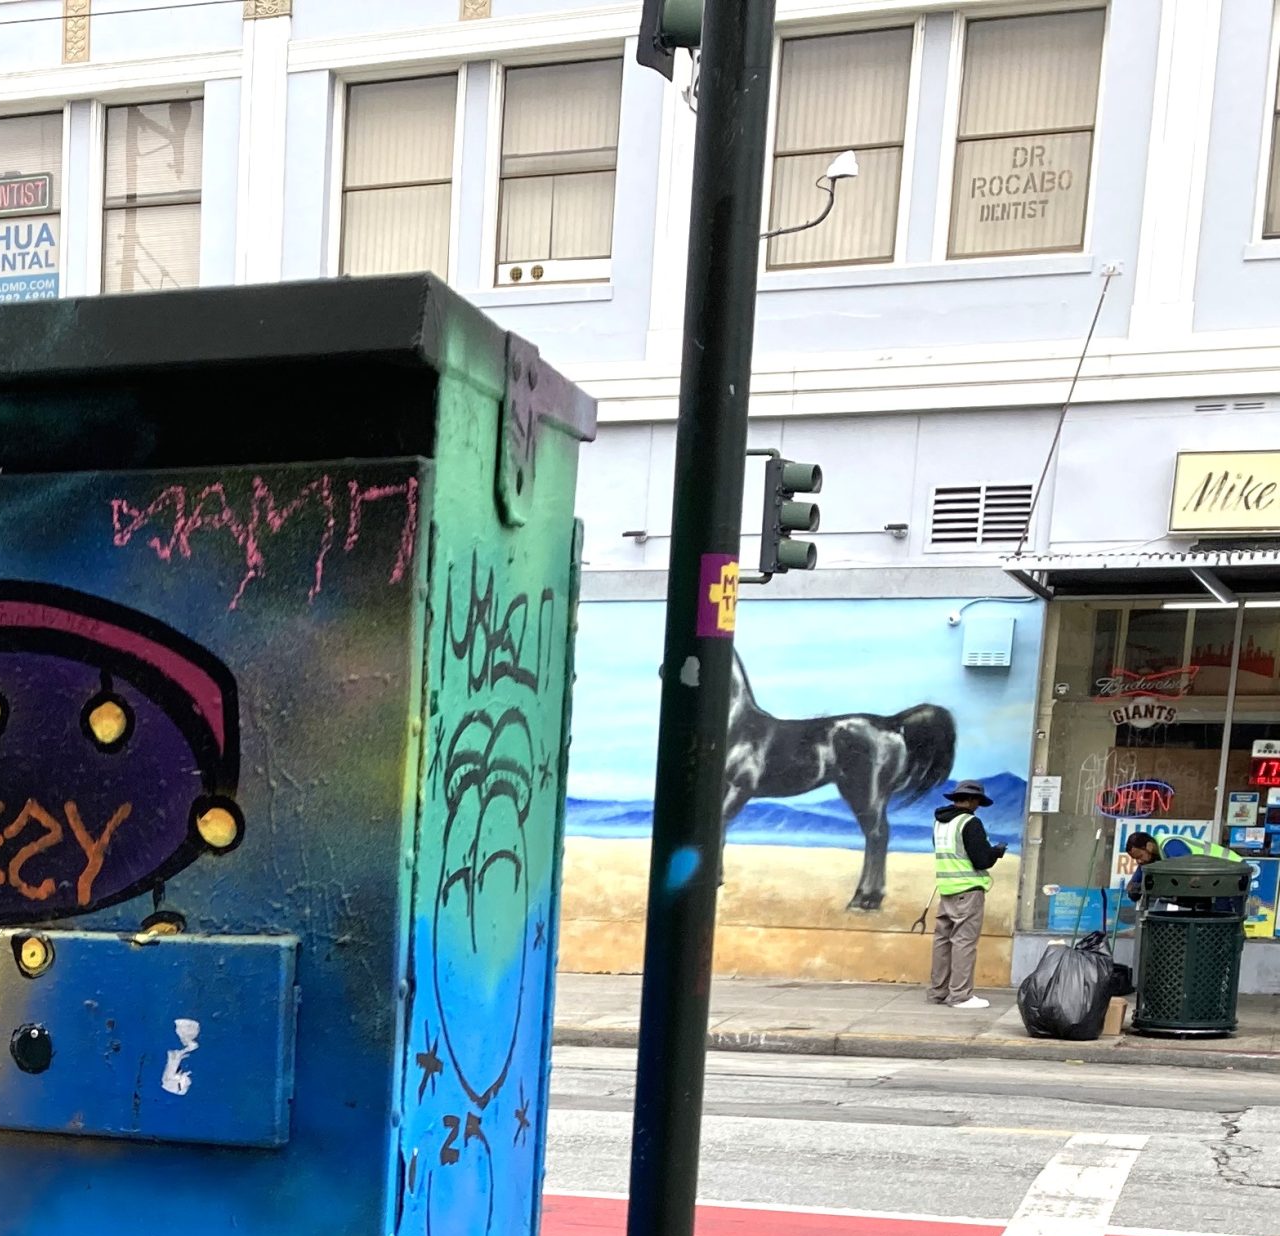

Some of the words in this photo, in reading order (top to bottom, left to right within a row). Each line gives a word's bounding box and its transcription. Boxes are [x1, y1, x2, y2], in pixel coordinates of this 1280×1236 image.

[1012, 145, 1053, 169] DR.
[971, 169, 1073, 199] ROCABO
[979, 199, 1049, 222] DENTIST
[1112, 703, 1177, 724] GIANTS
[1259, 761, 1280, 777] 17
[1097, 788, 1173, 812] OPEN
